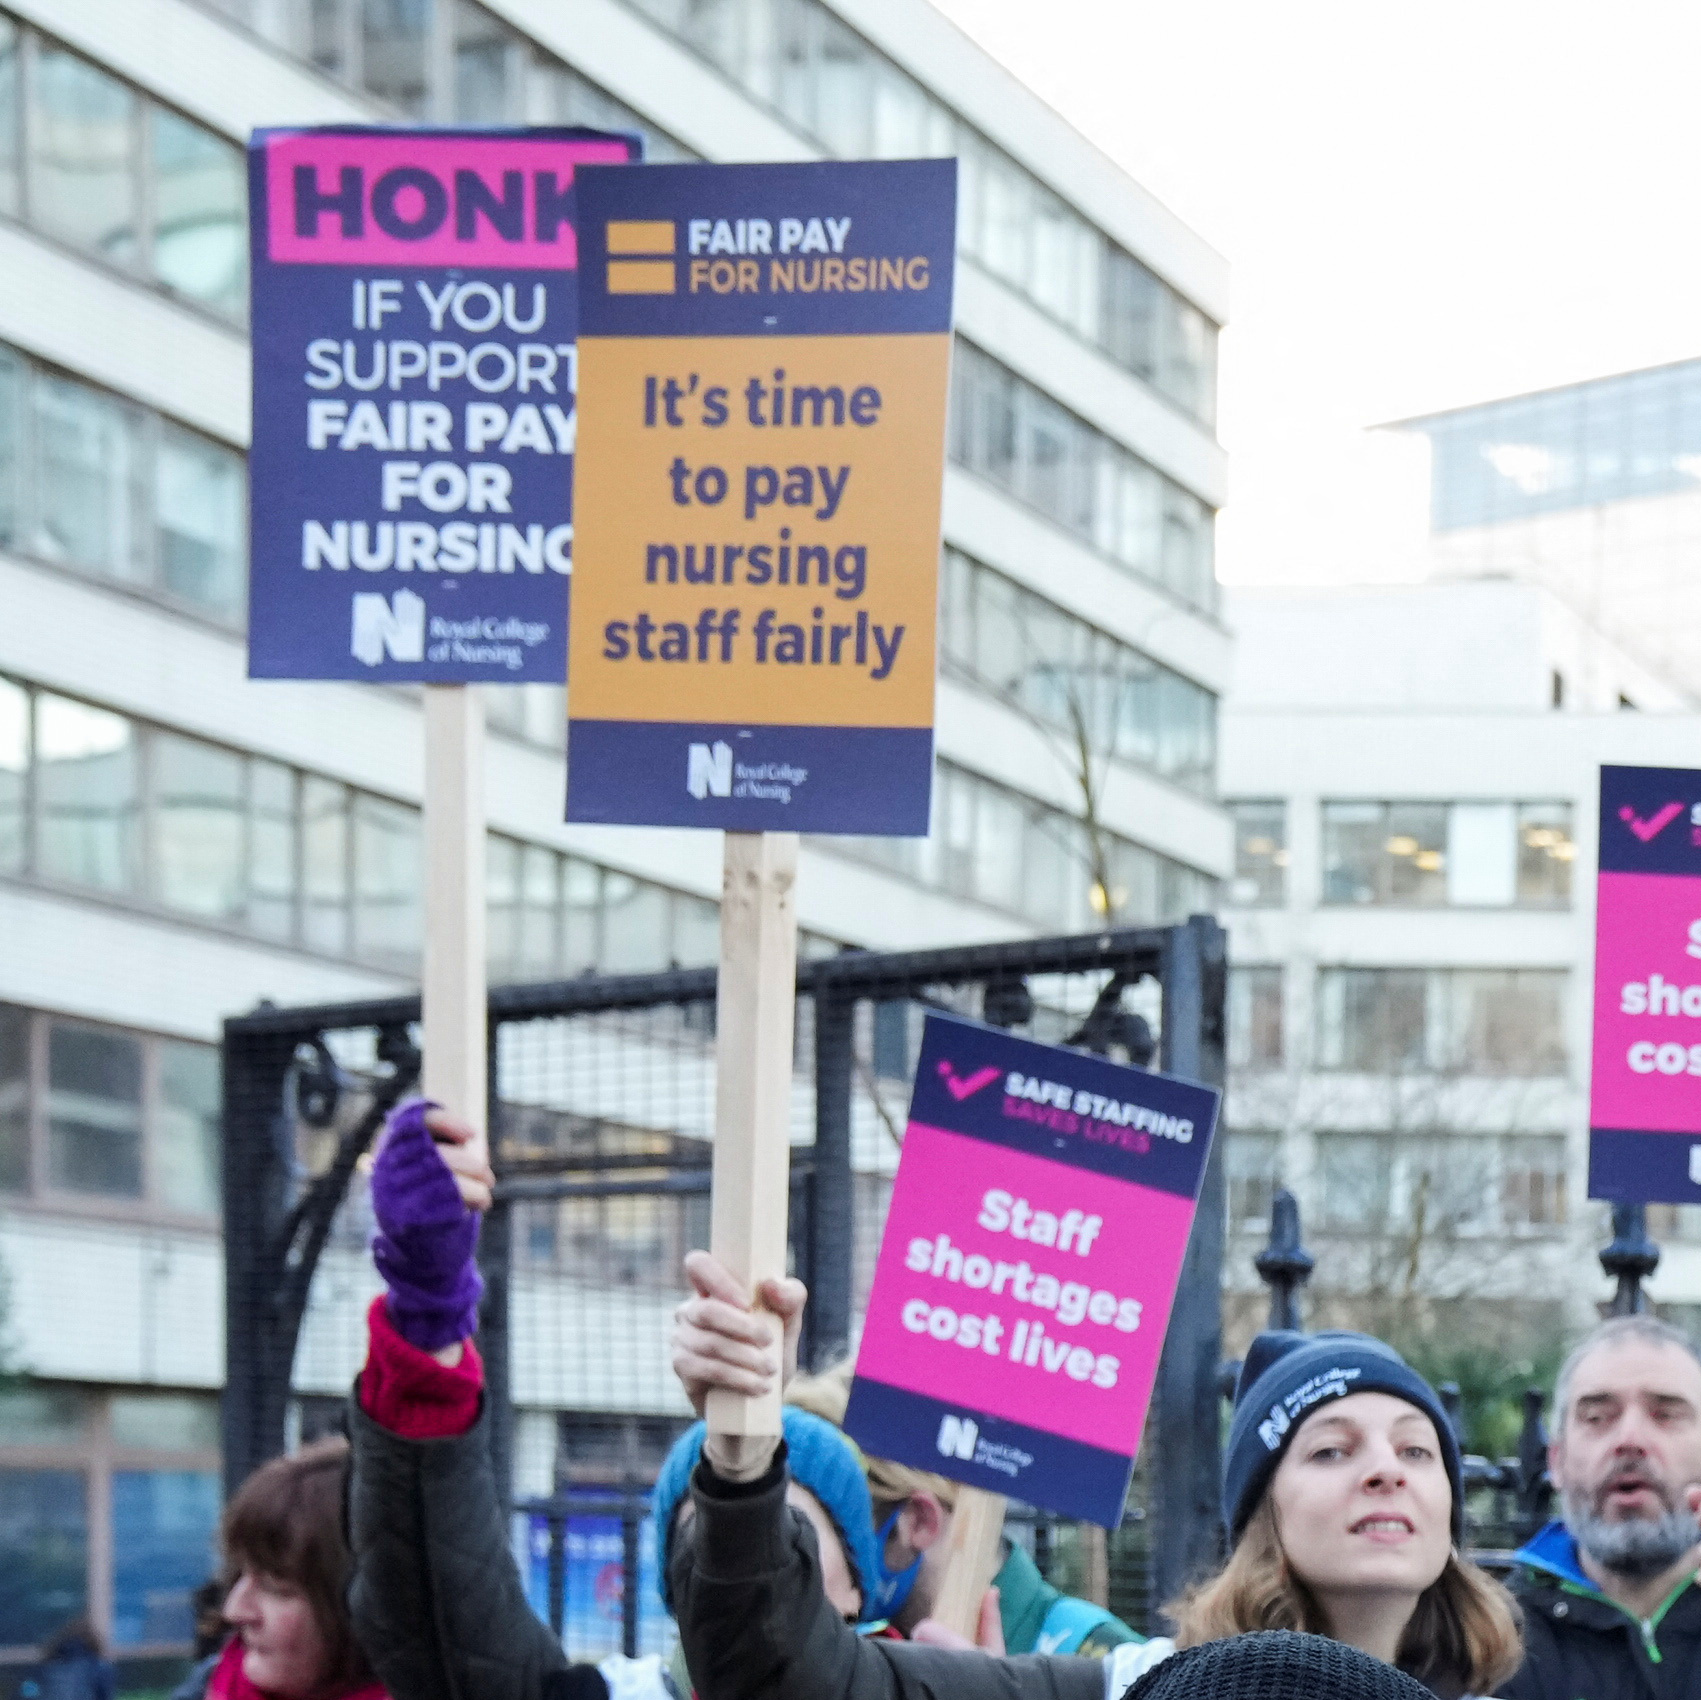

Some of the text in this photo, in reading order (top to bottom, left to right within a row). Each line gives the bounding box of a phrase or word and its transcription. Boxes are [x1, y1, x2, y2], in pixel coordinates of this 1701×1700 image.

[688, 217, 851, 255] FAIR PAY
[690, 255, 930, 294] FOR NURSING
[352, 279, 547, 333] IF YOU
[305, 338, 577, 393] SUPPORT
[307, 399, 577, 454] FAIR PAY
[644, 367, 882, 428] It's time
[382, 460, 512, 513] FOR
[670, 456, 851, 519] to pay
[645, 527, 867, 601] nursing
[603, 605, 905, 680] staff fairly
[1003, 1094, 1151, 1154] SAVES LIVES
[1004, 1071, 1194, 1145] SAFE STAFFING
[977, 1188, 1103, 1257] Staff
[905, 1233, 1143, 1333] shortages
[902, 1298, 1120, 1389] cost lives
